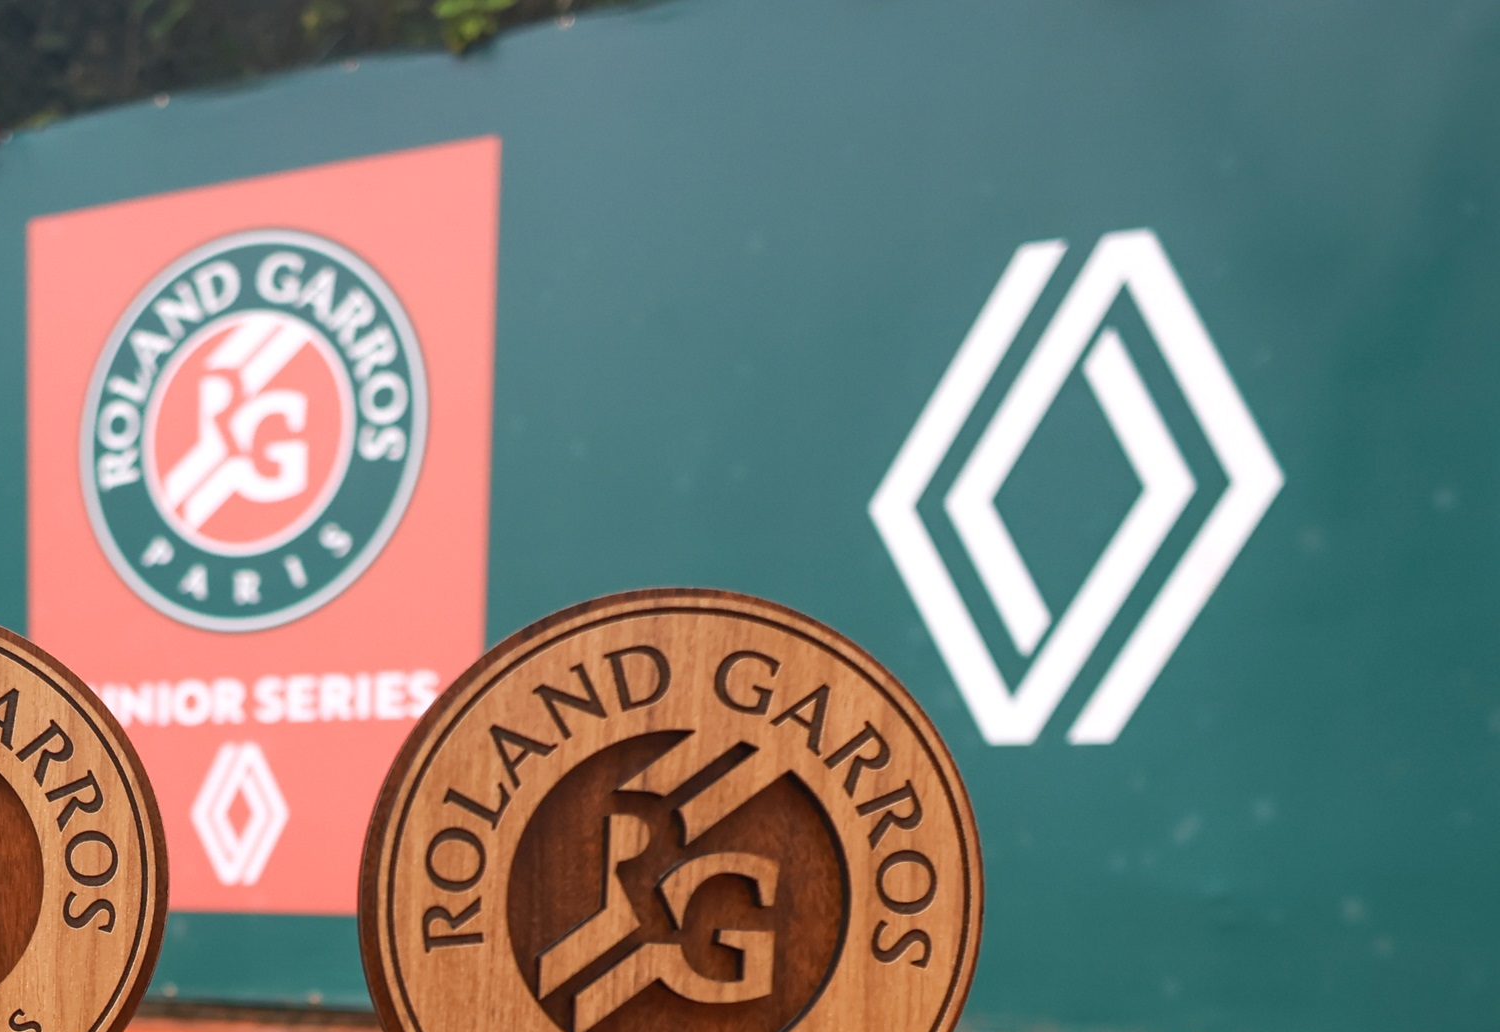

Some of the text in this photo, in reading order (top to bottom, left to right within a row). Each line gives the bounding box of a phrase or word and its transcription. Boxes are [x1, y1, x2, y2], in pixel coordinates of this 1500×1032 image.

[97, 251, 409, 490] ROLAND GARROS
[140, 522, 353, 605] PARIS
[88, 669, 441, 727] NIOR SERIES
[422, 644, 938, 970] ROLAND GARROS
